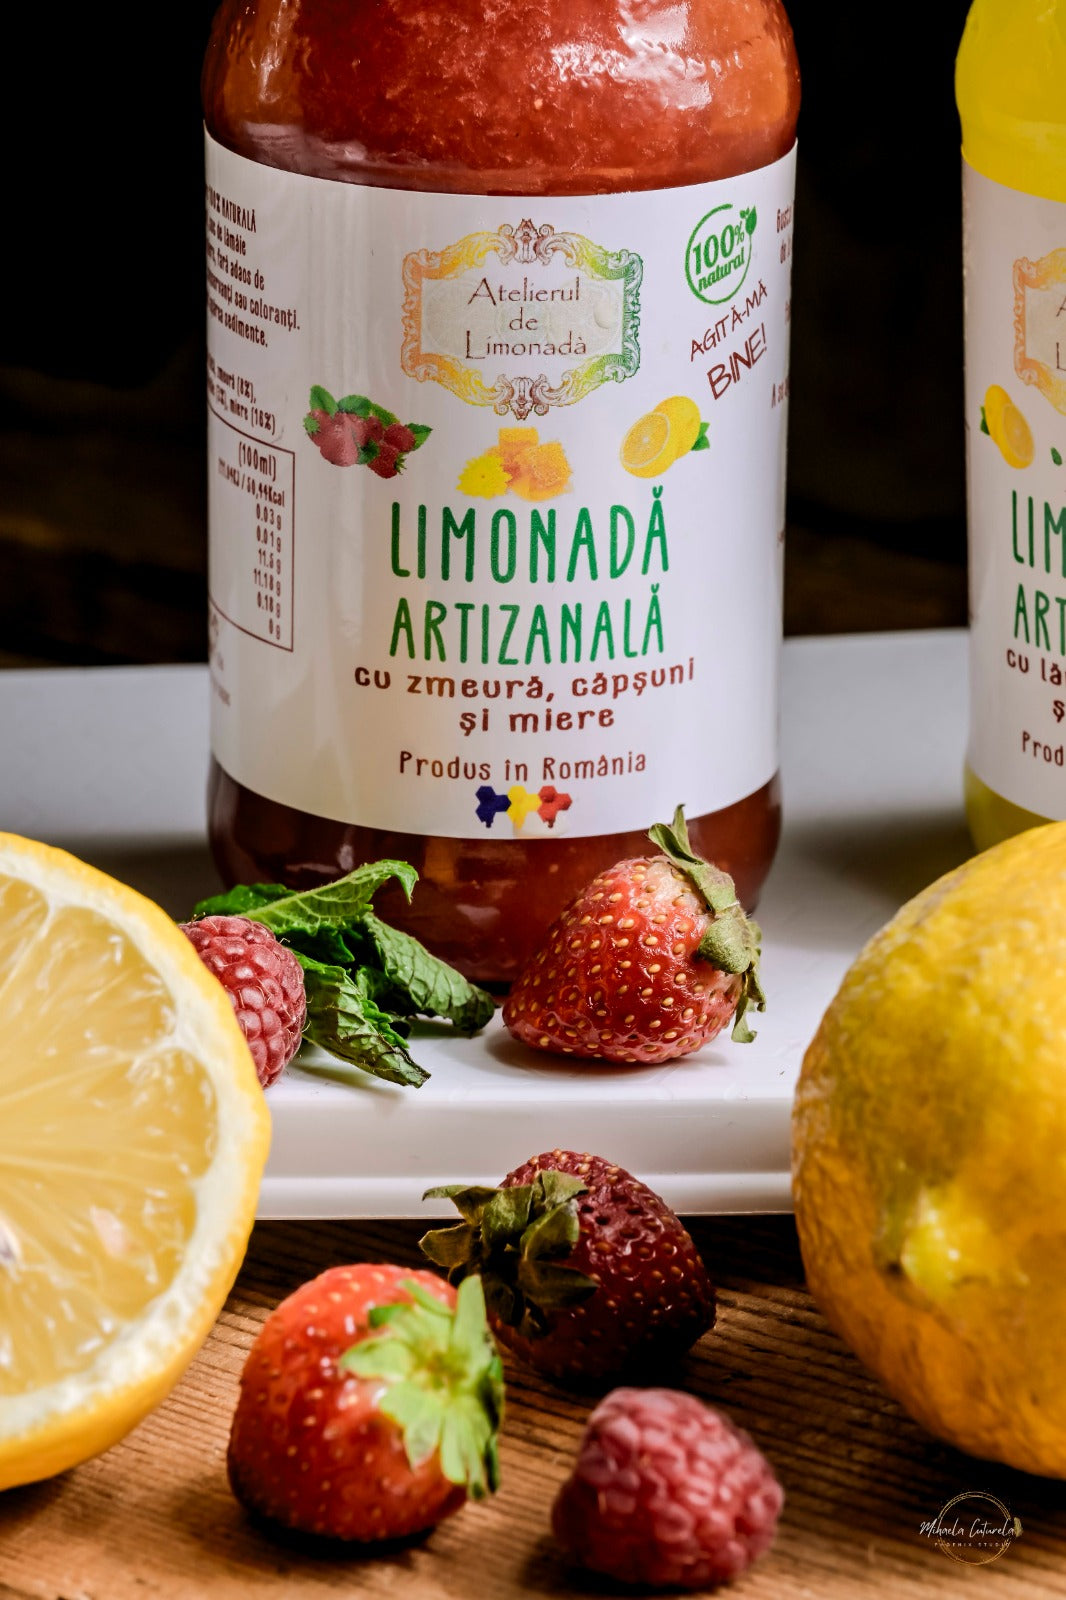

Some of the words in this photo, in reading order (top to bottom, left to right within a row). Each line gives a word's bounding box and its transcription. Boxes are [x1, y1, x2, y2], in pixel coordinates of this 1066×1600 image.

[692, 220, 745, 276] 100%
[254, 269, 265, 292] de
[698, 246, 745, 292] natural
[234, 291, 248, 312] sau
[467, 276, 580, 306] Atelierul
[224, 312, 269, 348] sedimente.
[509, 306, 538, 331] de
[707, 322, 768, 401] BINE!
[239, 441, 277, 482] (100ml)
[391, 485, 669, 584] LIMONADĂ
[389, 582, 665, 665] ARTIZANALĂ
[1006, 649, 1030, 674] cu
[354, 666, 391, 689] cu
[407, 675, 555, 702] zmeură,
[509, 708, 615, 734] miere
[400, 750, 491, 781] Produs
[505, 758, 528, 782] în
[542, 750, 646, 782] România
[1022, 731, 1065, 767] Prod
